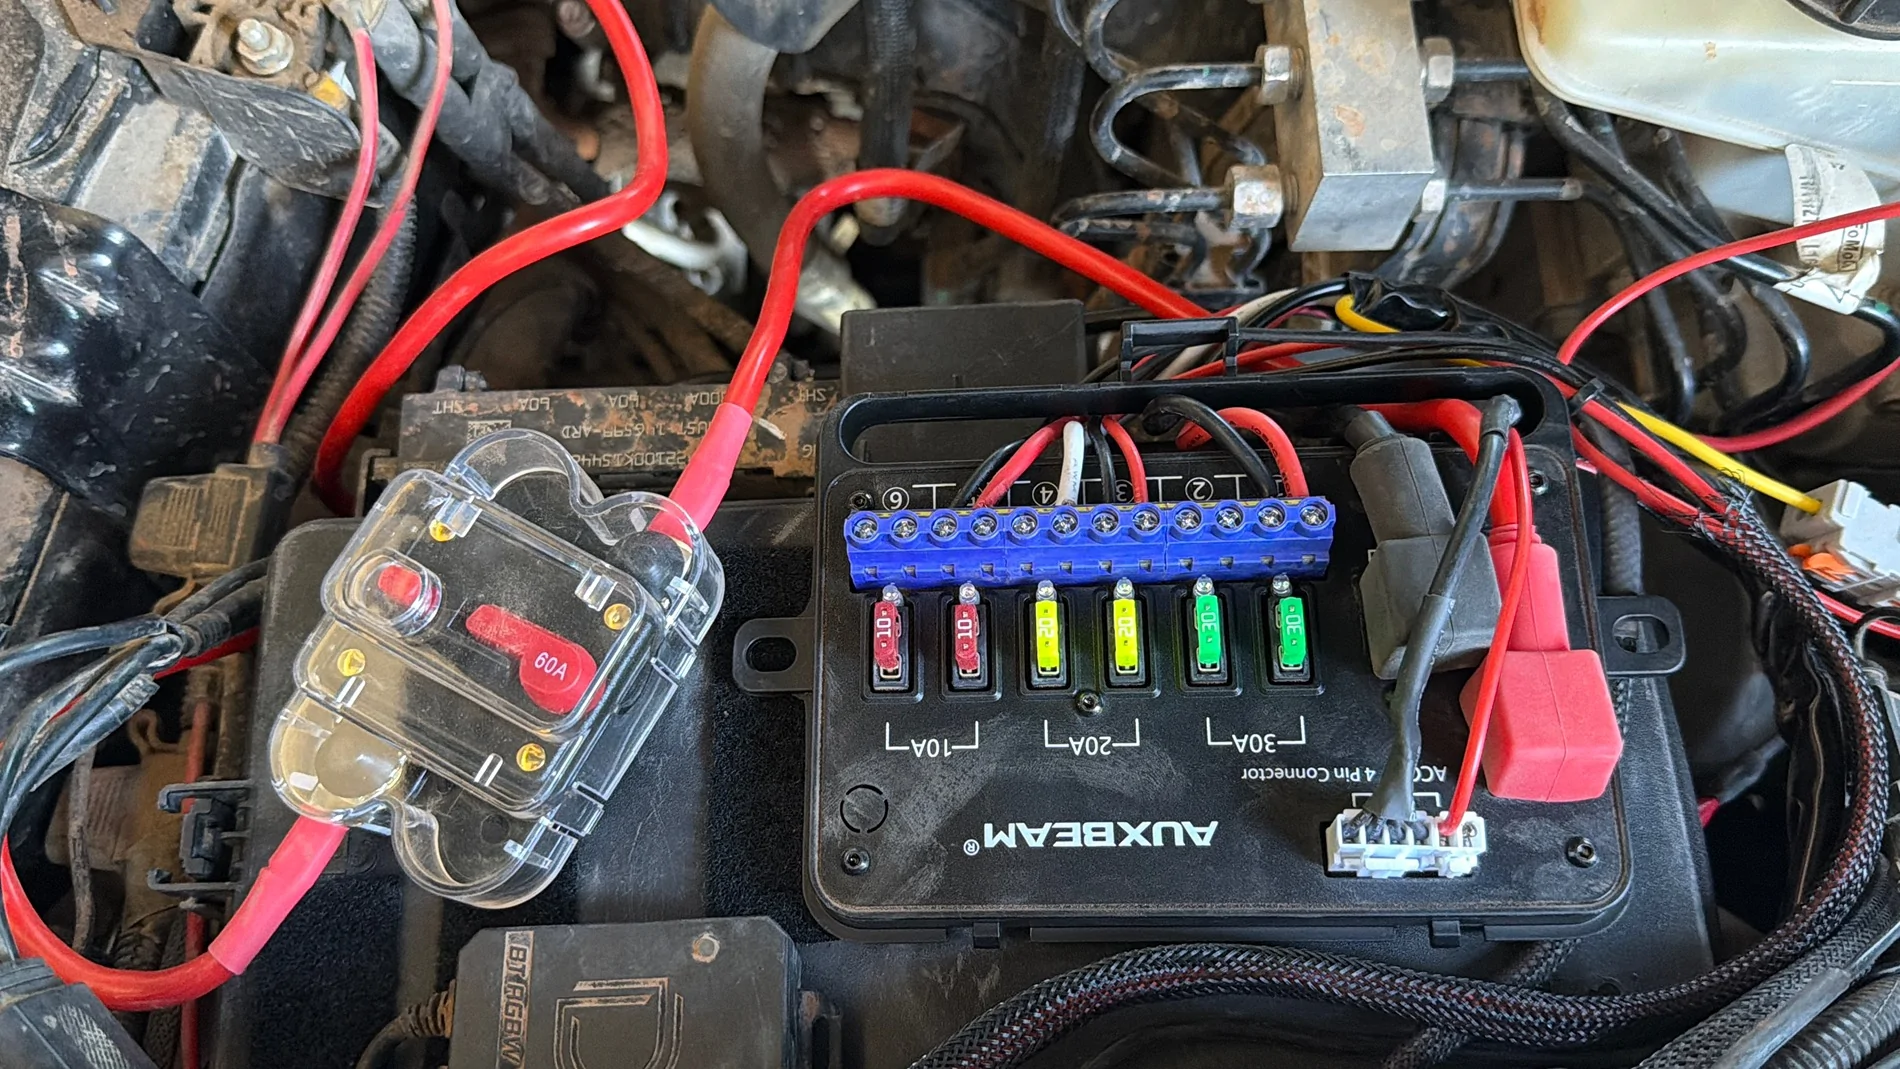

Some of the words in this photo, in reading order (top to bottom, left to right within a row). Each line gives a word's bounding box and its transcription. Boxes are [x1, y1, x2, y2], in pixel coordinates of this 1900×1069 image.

[689, 391, 725, 405] 00A
[876, 618, 891, 638] 10
[958, 619, 972, 640] 10
[1201, 612, 1217, 633] 30
[1286, 614, 1302, 636] 30
[534, 651, 568, 681] 60A
[911, 738, 952, 757] 10A
[1068, 736, 1112, 755] 20A
[1232, 733, 1277, 753] 30A
[1241, 768, 1330, 782] Connector
[1334, 768, 1360, 781] Pin
[1364, 768, 1376, 780] 4
[508, 944, 529, 980] BT
